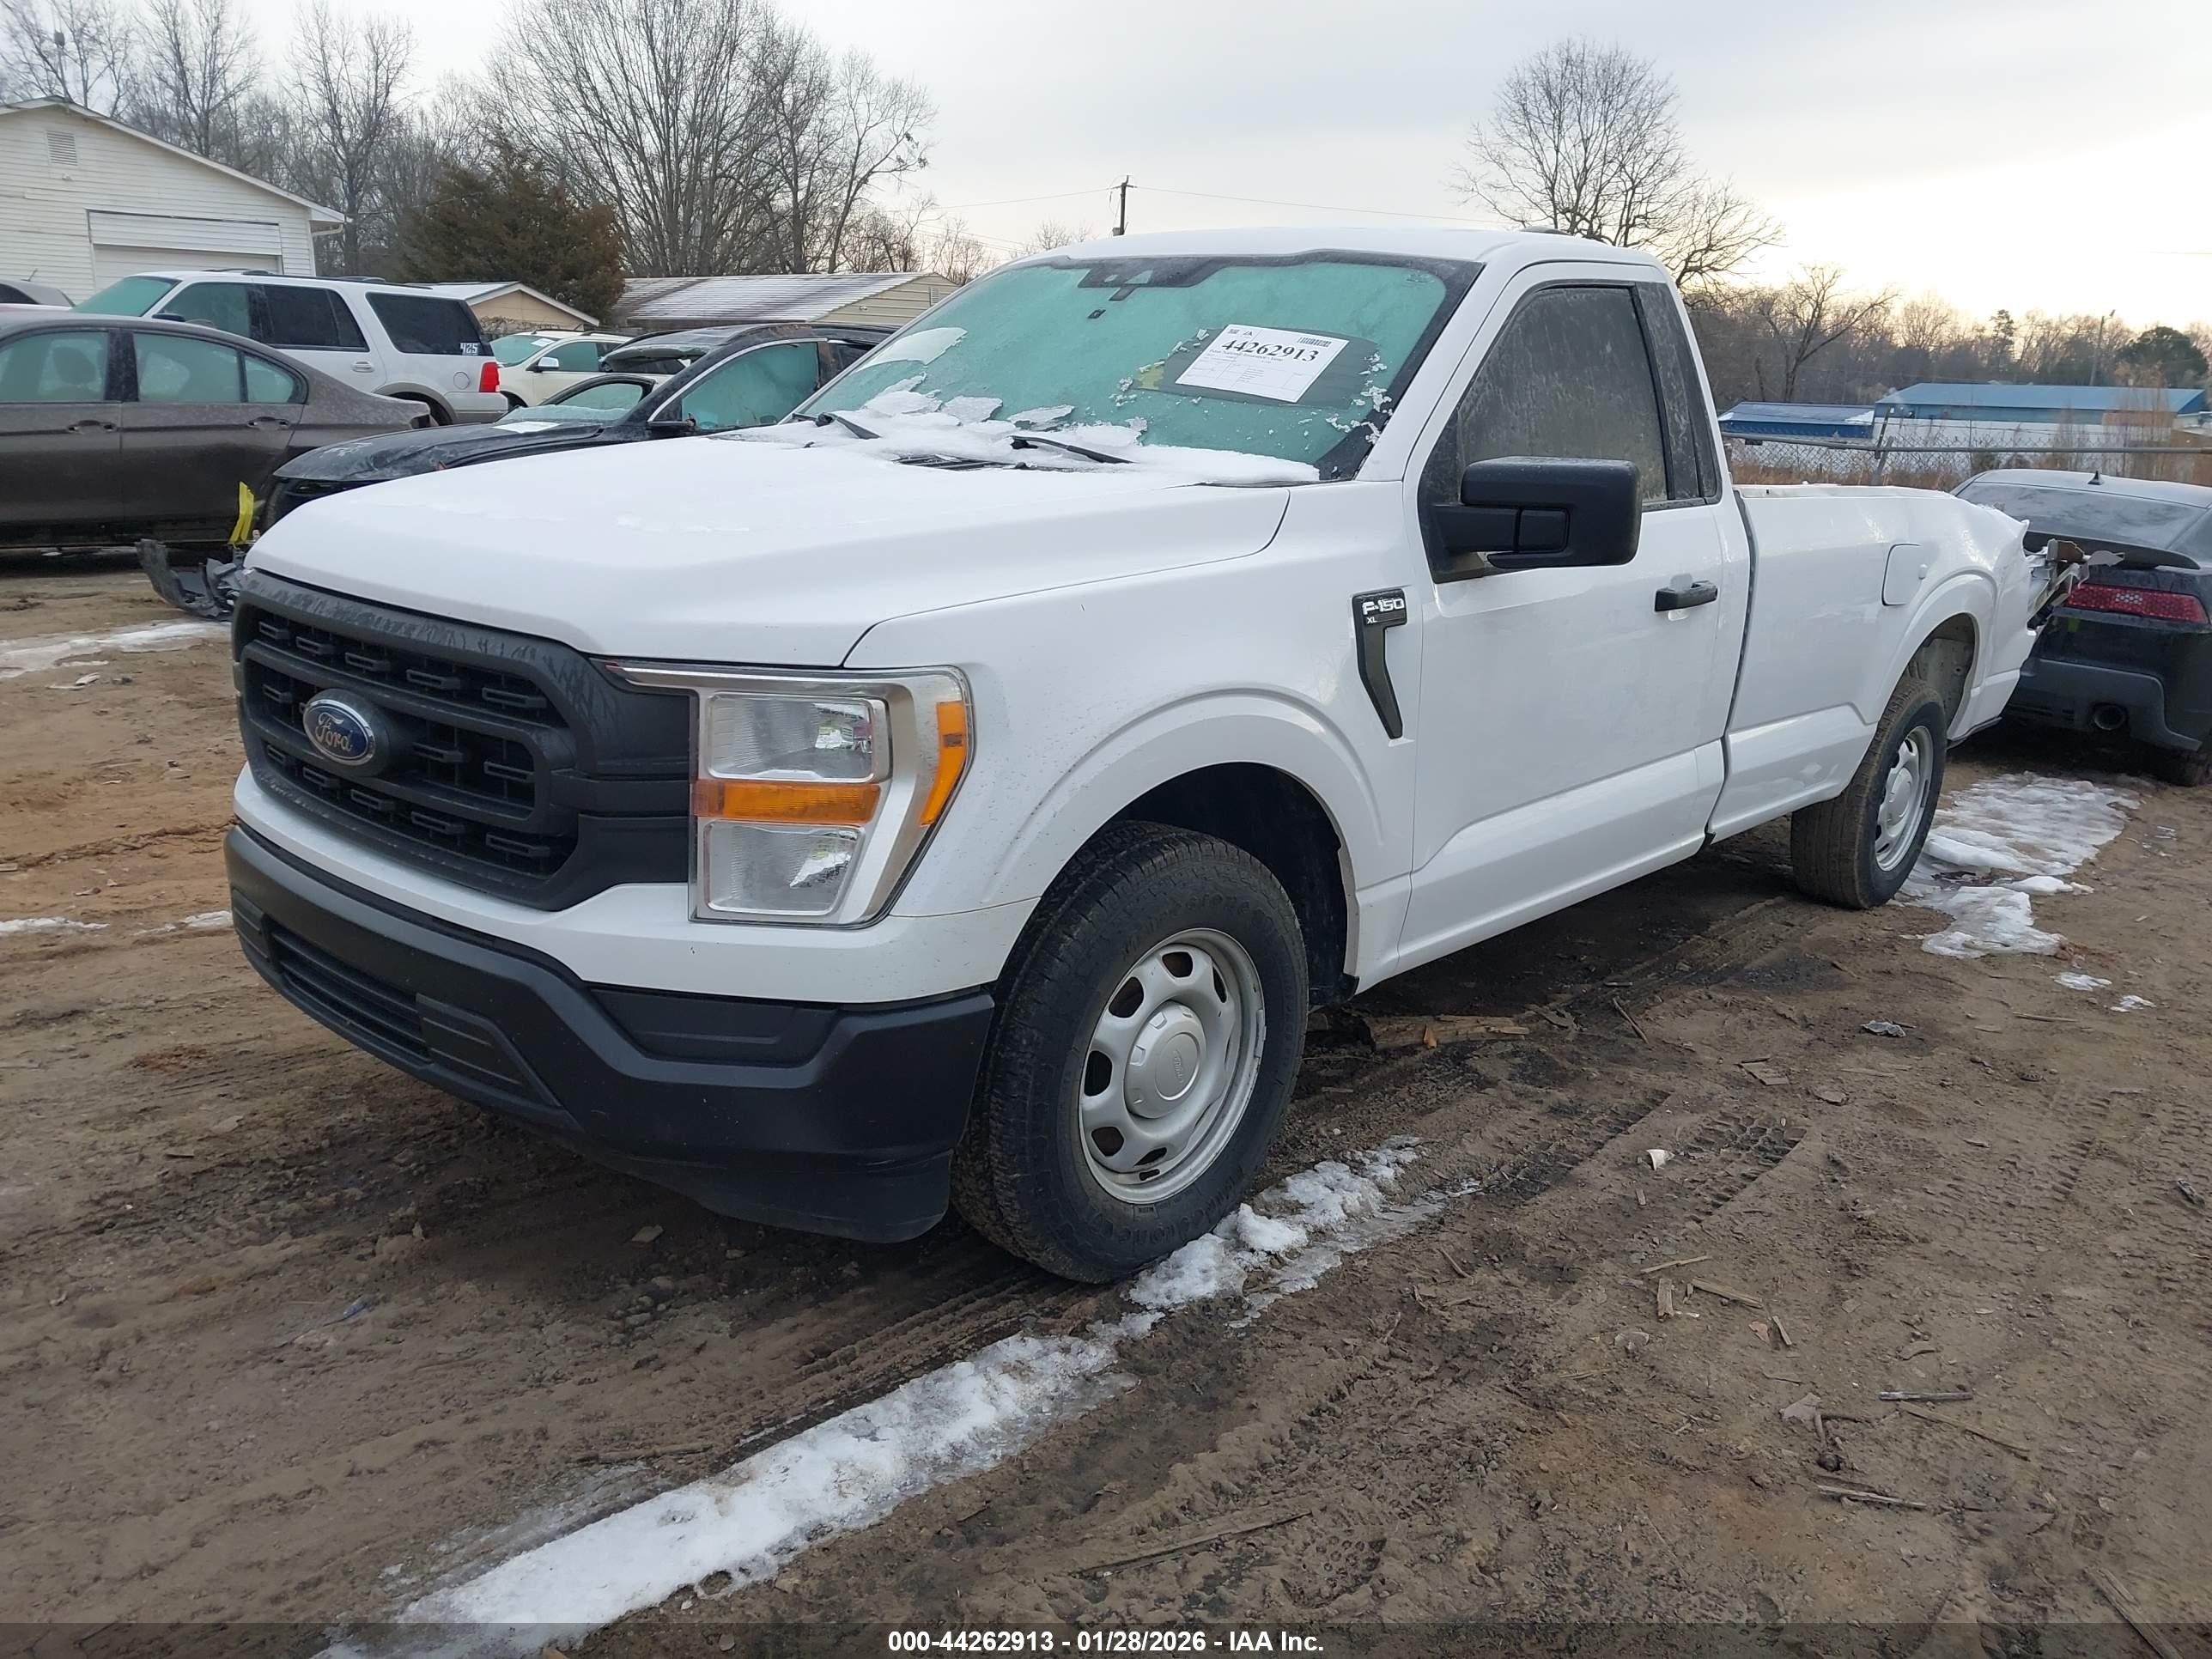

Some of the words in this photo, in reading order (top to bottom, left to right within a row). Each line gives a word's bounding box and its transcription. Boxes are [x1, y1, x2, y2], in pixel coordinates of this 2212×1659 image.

[1222, 339, 1319, 362] 44262913
[1362, 598, 1405, 616] F-150
[315, 712, 354, 752] Ford
